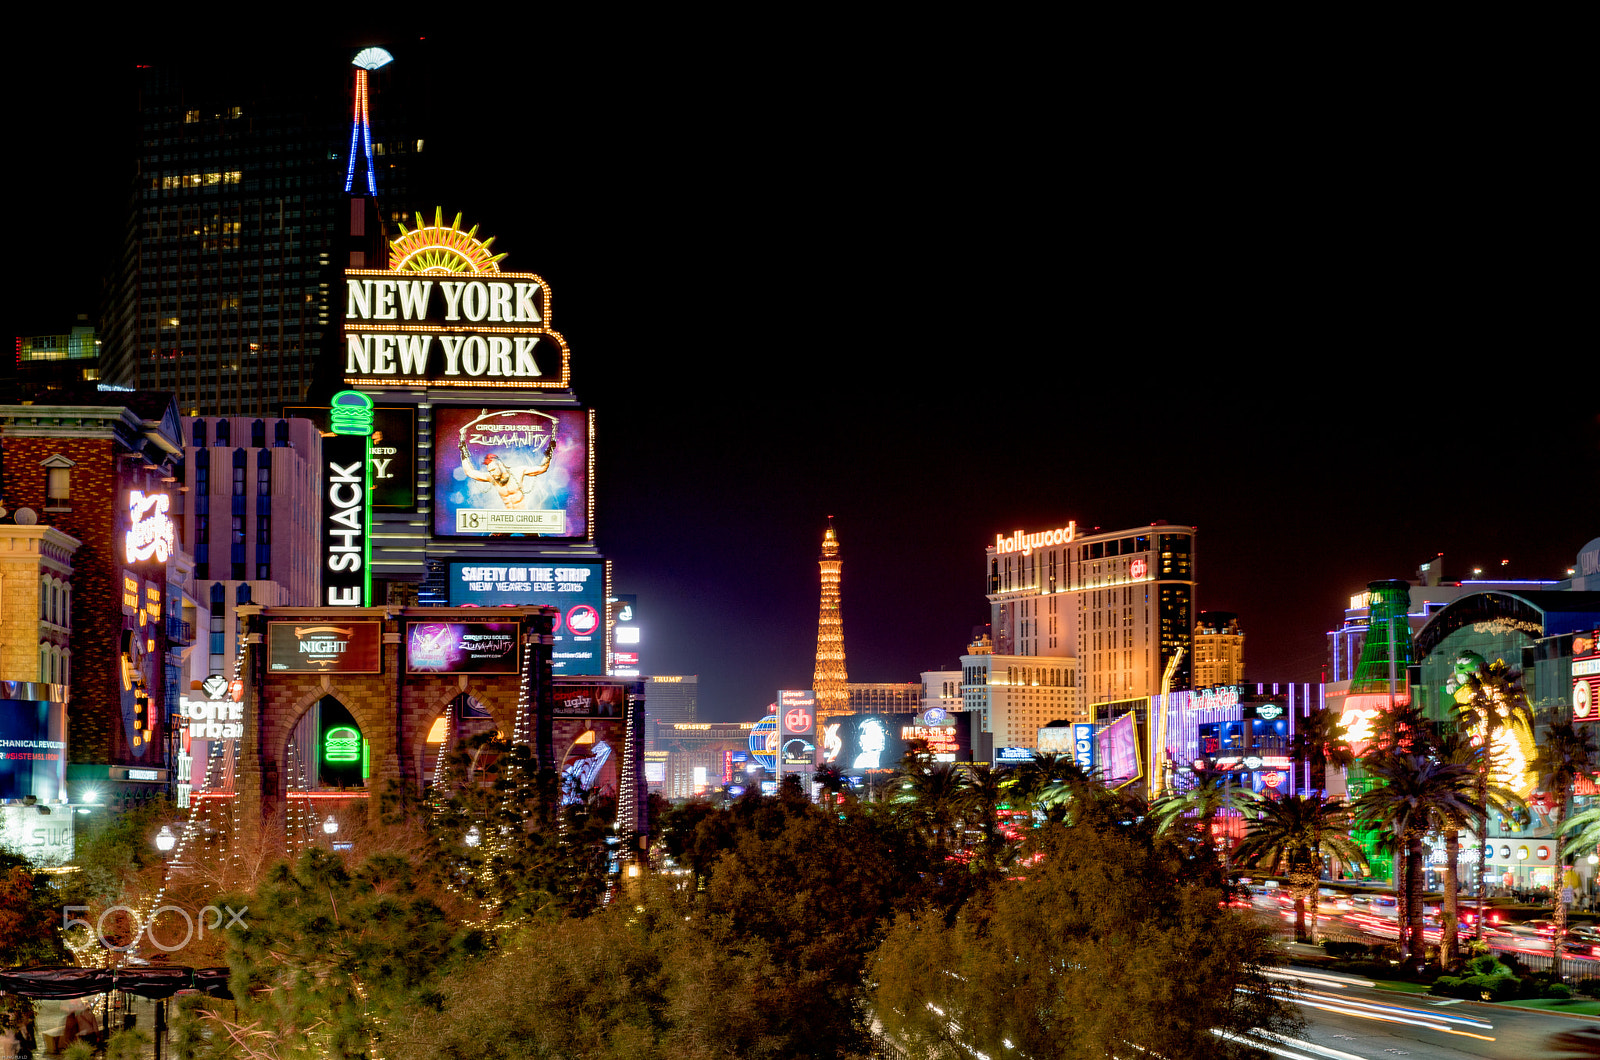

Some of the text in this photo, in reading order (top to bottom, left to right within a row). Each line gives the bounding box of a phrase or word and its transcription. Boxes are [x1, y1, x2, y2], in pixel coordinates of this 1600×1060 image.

[346, 280, 542, 322] NEW YORK
[345, 334, 542, 377] NEW YORK
[328, 461, 363, 573] SHACK
[516, 515, 543, 523] CIRQUE
[996, 521, 1076, 556] hollywood
[461, 567, 591, 582] SAFETY ON THE STRIP
[469, 582, 494, 592] NEW
[534, 583, 555, 592] EVE
[299, 640, 349, 653] NIGHT
[782, 690, 805, 699] planet
[564, 696, 592, 708] ugly
[782, 698, 814, 707] hollywood
[673, 722, 712, 731] TREASURE
[786, 708, 811, 731] ph
[1076, 726, 1091, 772] ROS
